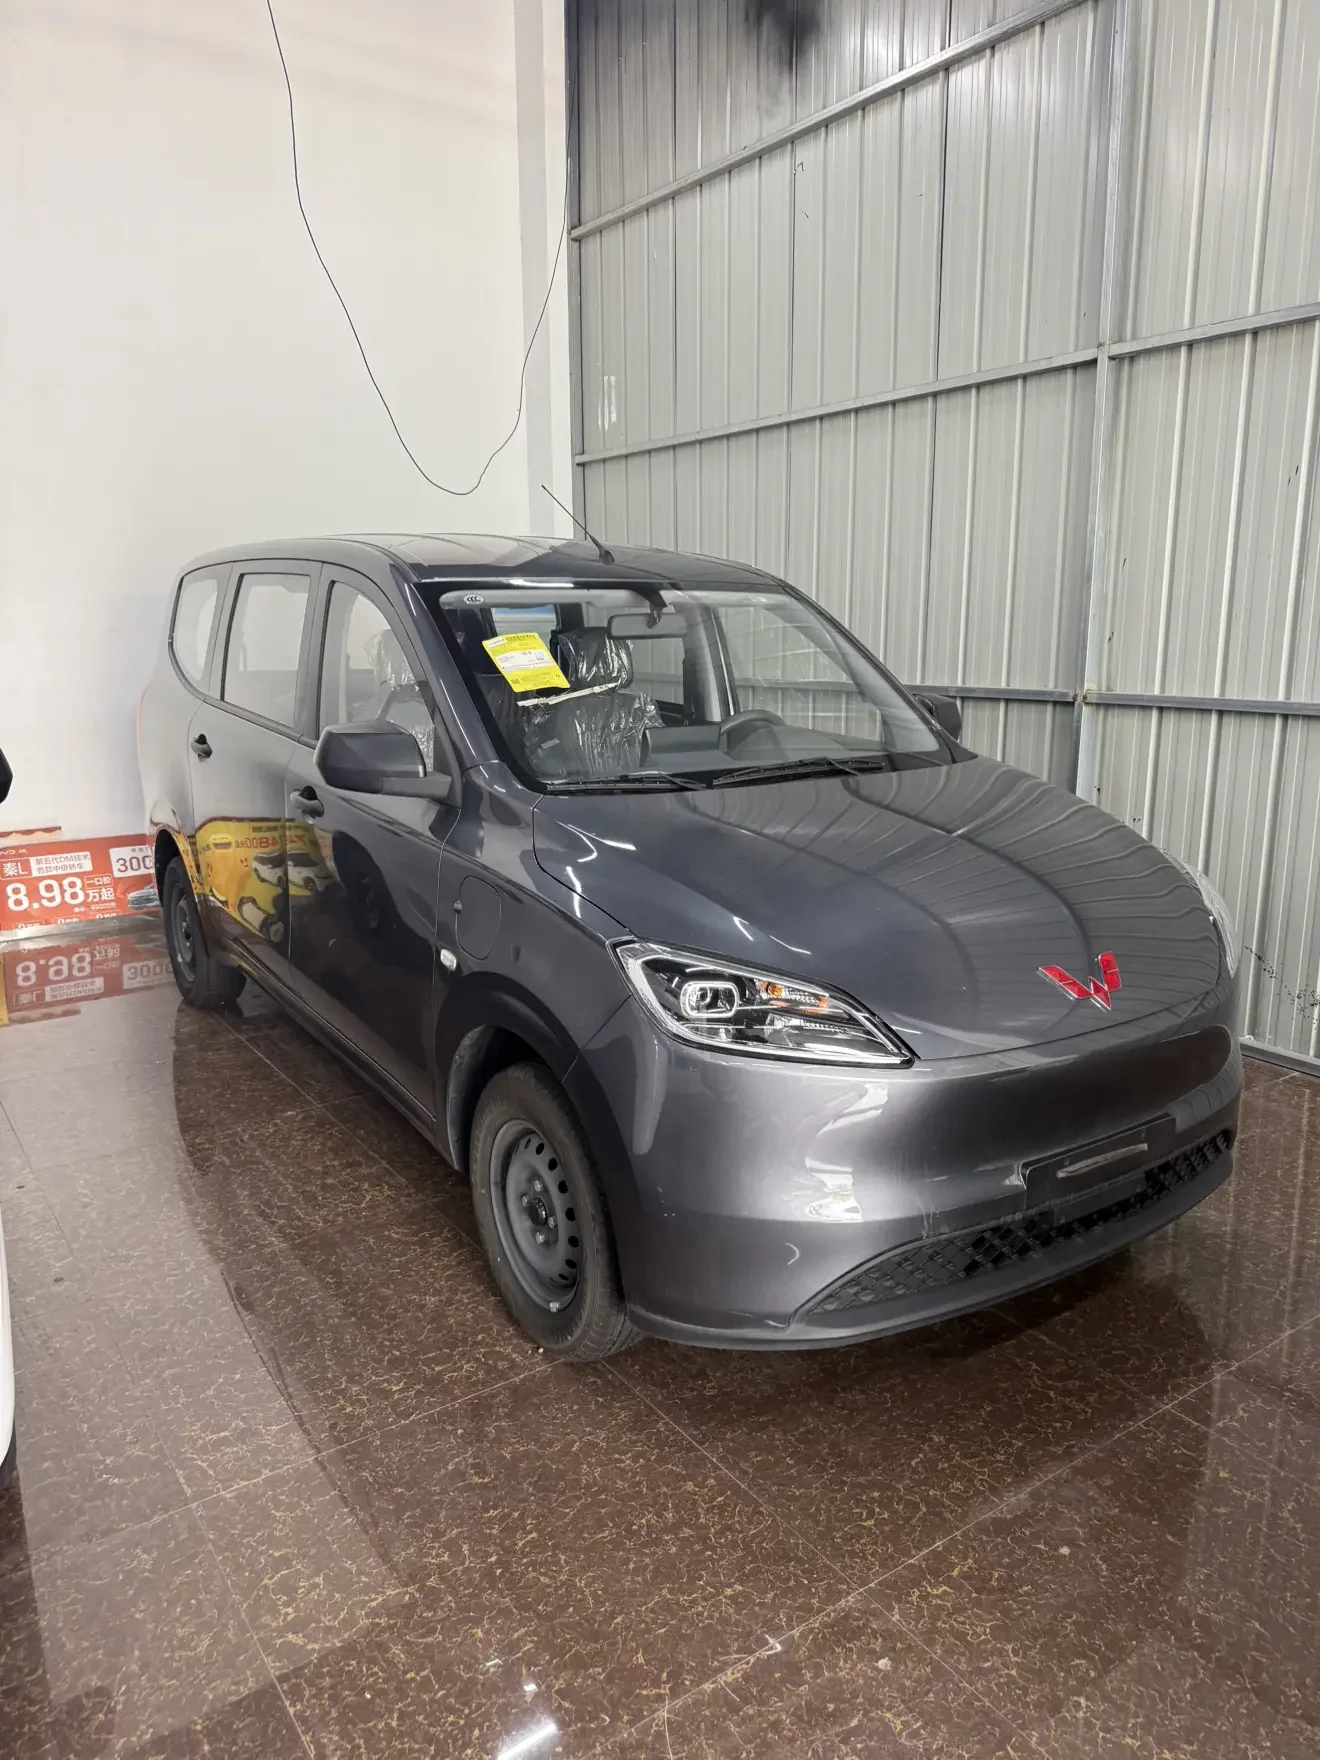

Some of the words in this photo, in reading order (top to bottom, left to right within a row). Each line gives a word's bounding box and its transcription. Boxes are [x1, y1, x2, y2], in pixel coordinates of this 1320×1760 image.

[3, 861, 28, 876] 秦L
[86, 876, 112, 886] 一口价
[6, 876, 85, 911] 8.98
[86, 887, 116, 902] 万起
